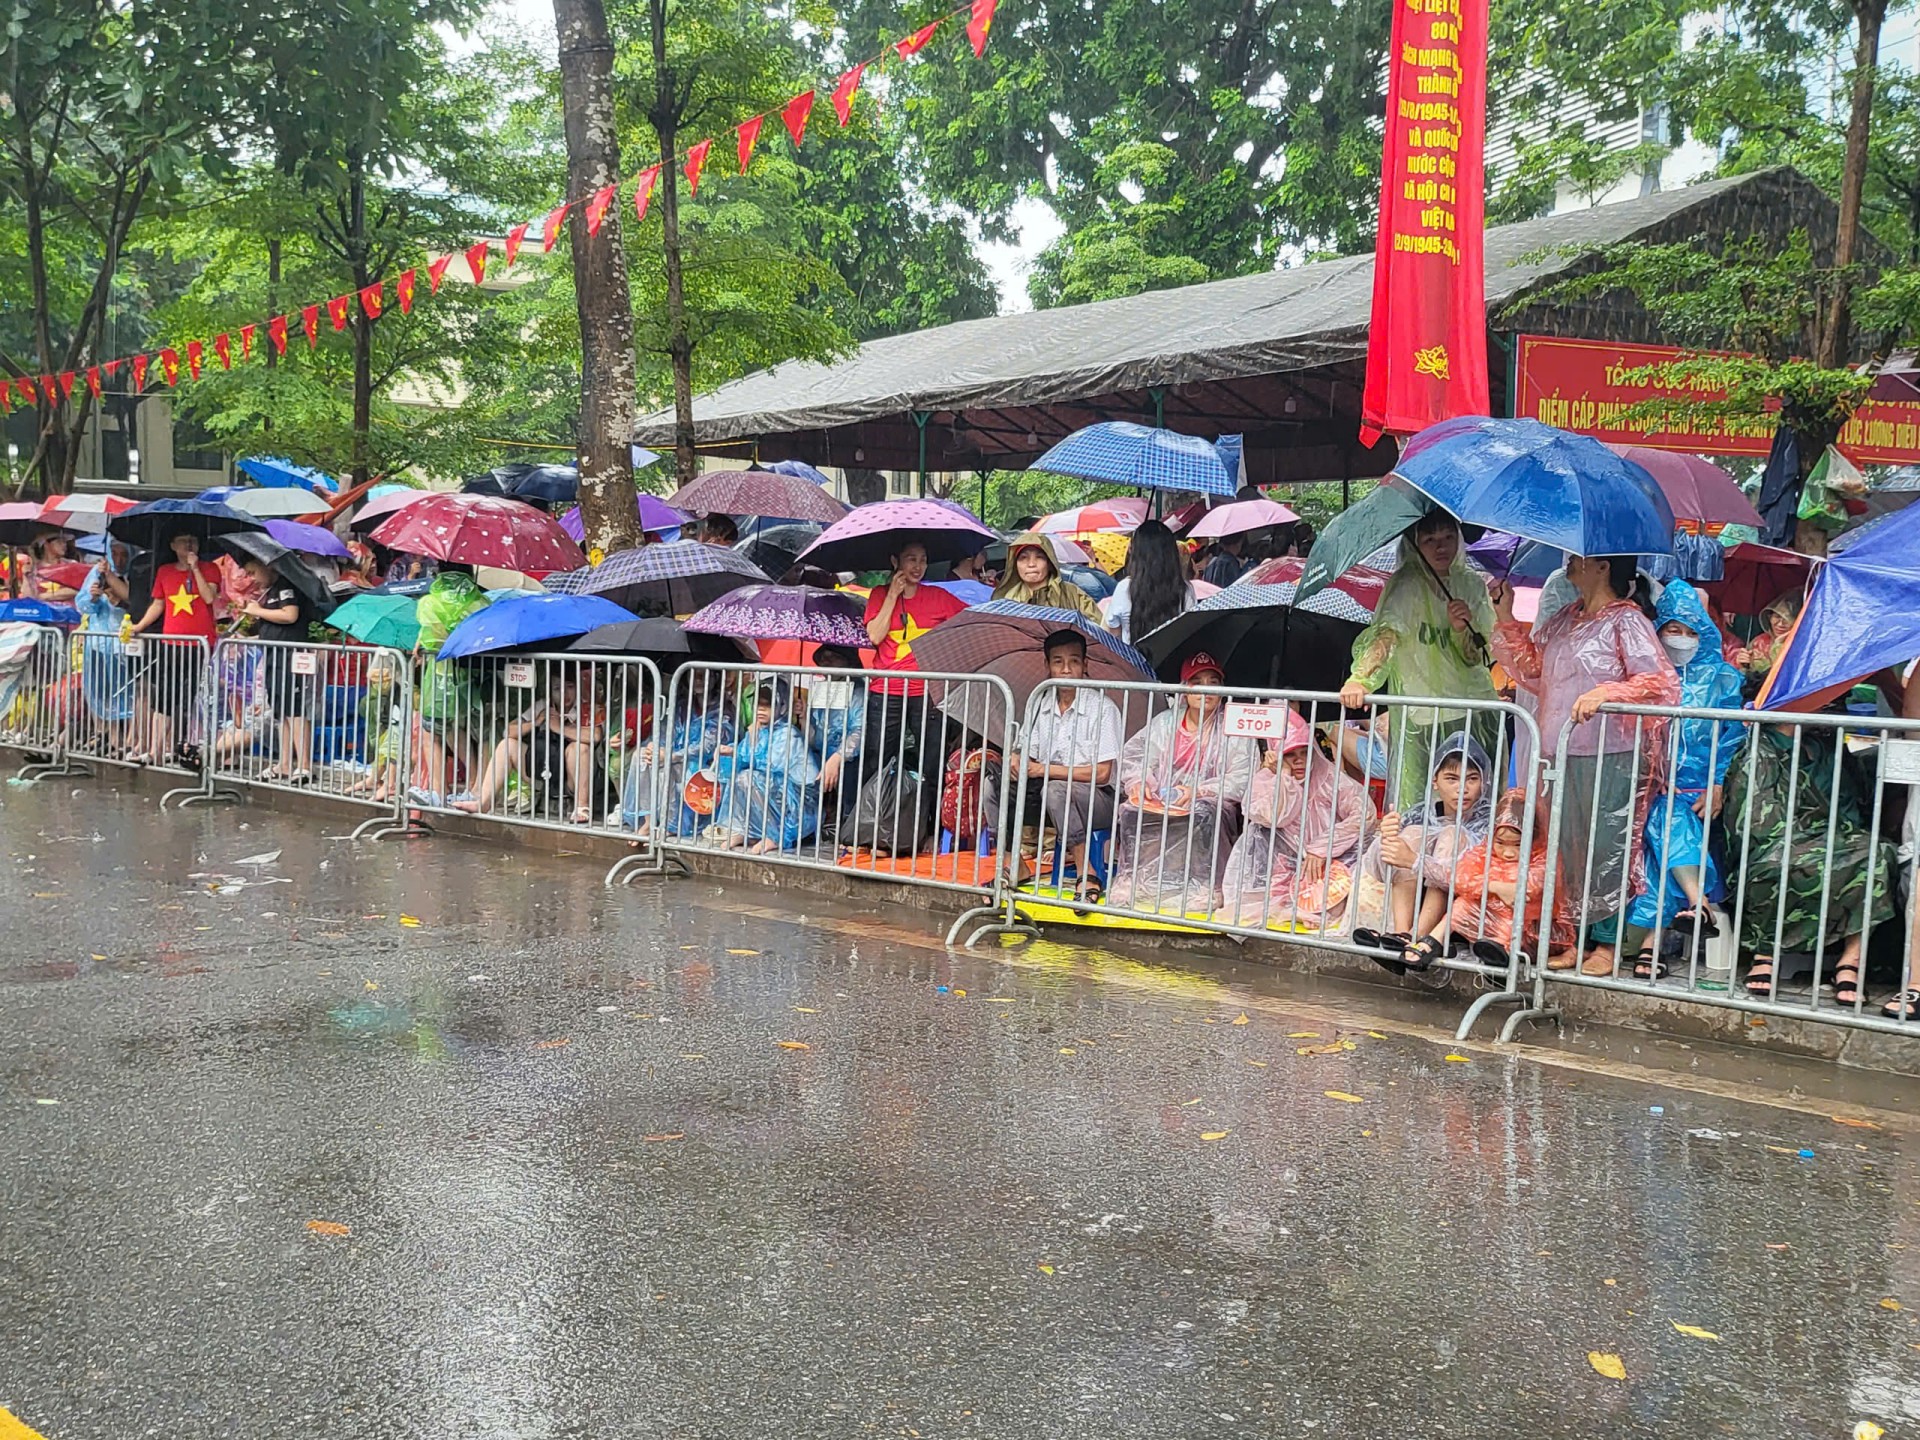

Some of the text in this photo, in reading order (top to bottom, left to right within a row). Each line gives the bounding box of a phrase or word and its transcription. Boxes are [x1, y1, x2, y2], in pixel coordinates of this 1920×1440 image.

[1431, 21, 1448, 39] 80
[1418, 49, 1451, 70] MẠNG
[1409, 126, 1421, 147] VÀ
[1417, 180, 1438, 204] HỘI
[1421, 206, 1445, 231] VIỆT
[1571, 390, 1595, 430] CẤP
[510, 674, 528, 682] STOP
[1237, 719, 1272, 731] STOP
